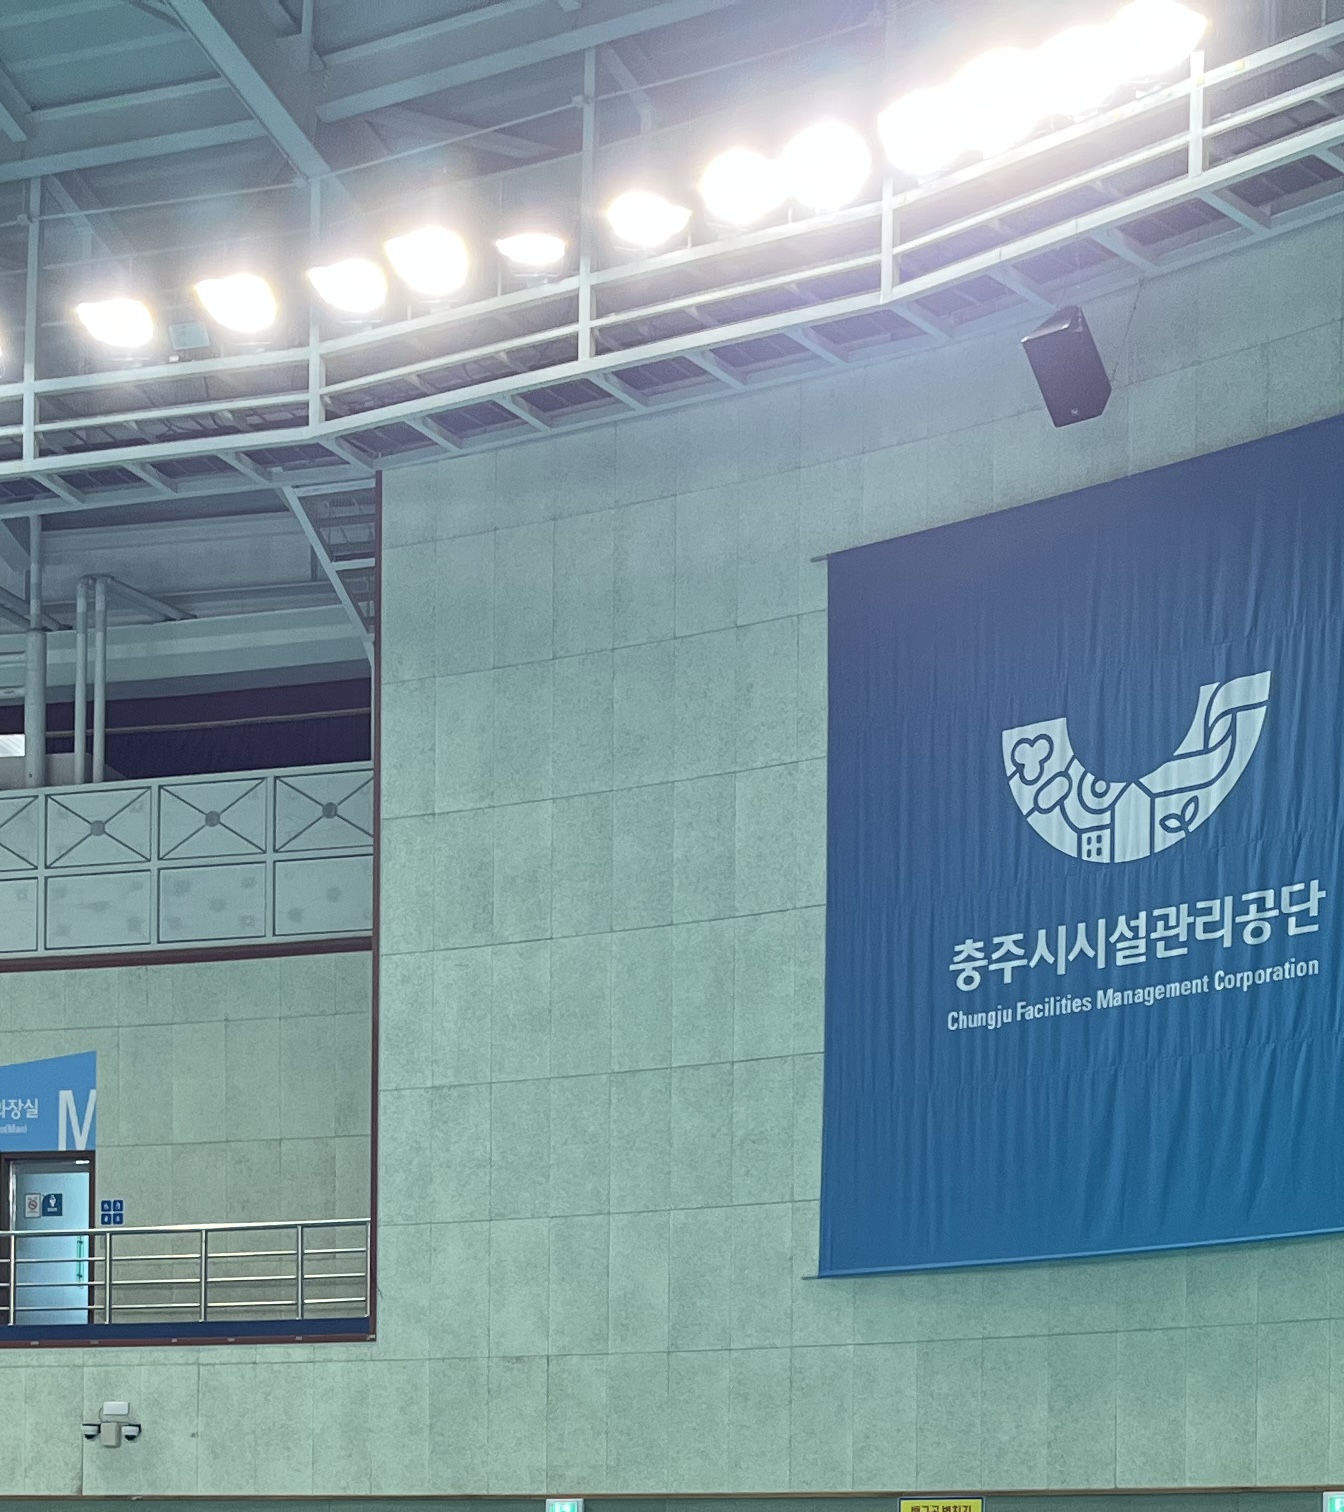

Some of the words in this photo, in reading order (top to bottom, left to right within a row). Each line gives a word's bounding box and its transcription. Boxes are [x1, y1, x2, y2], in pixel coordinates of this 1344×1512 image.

[949, 879, 1327, 992] 충주시시설관리공단
[947, 1004, 1013, 1031] Chungju
[1016, 994, 1092, 1021] Facilities
[1096, 975, 1209, 1010] Management
[1214, 957, 1319, 991] Corporation
[58, 1089, 96, 1151] M
